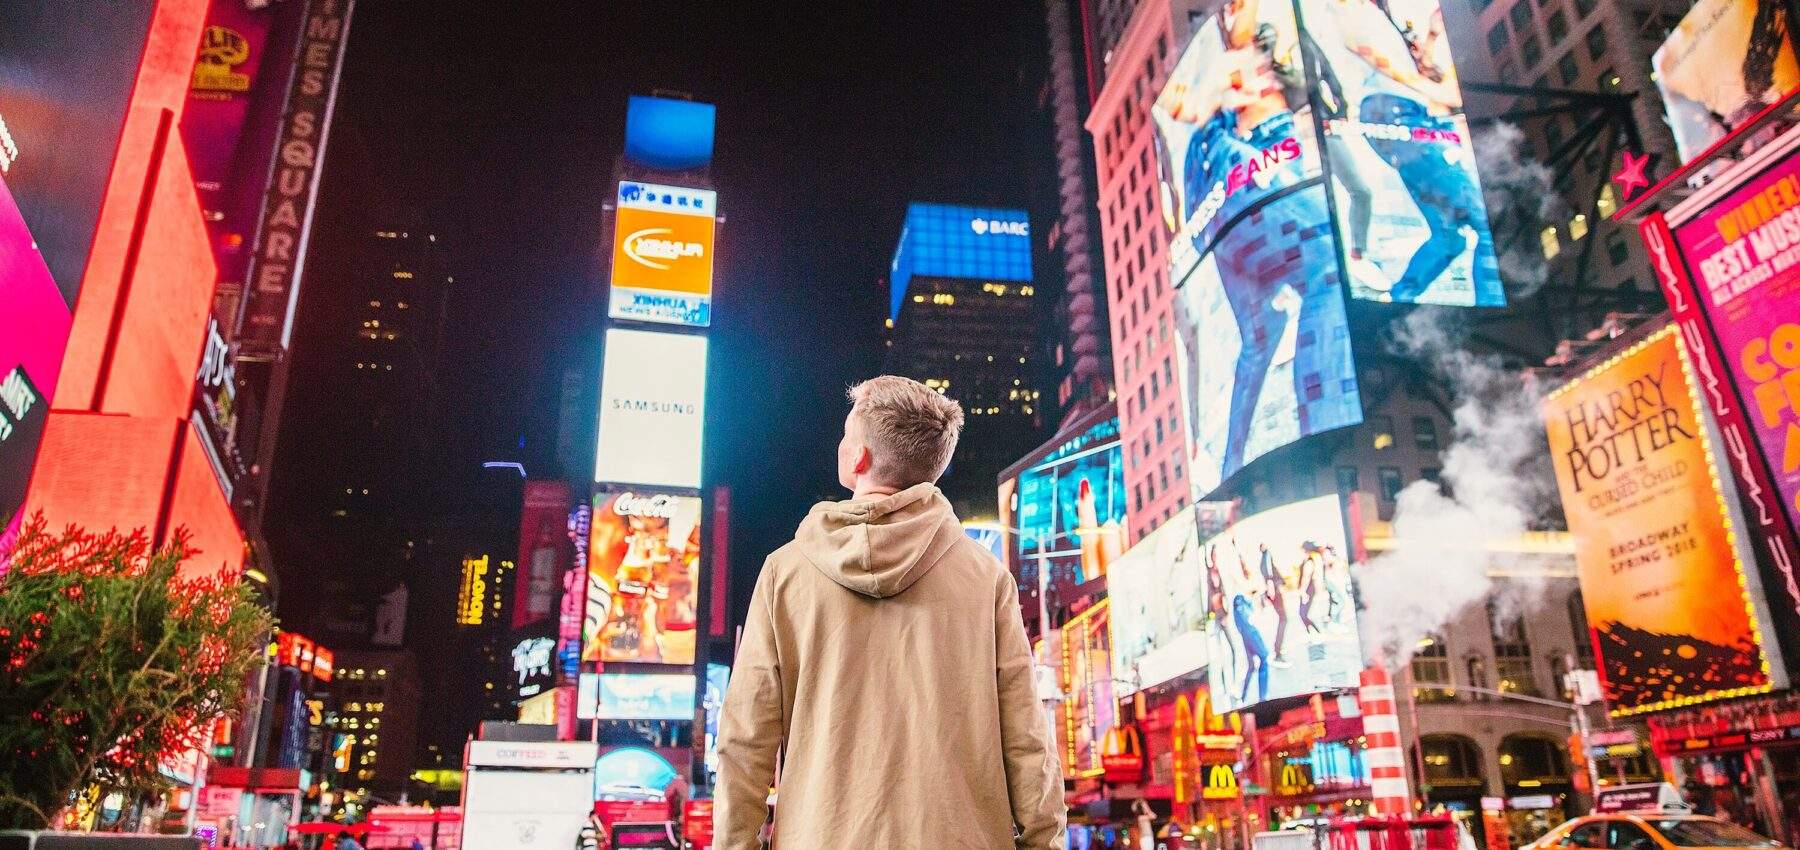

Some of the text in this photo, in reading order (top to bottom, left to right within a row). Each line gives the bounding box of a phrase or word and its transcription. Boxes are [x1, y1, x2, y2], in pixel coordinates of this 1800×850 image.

[1225, 137, 1302, 197] JEANS
[257, 110, 315, 293] SQUARE
[1700, 238, 1751, 291] BEST
[612, 398, 695, 415] SAMSUNG
[1566, 361, 1668, 449] HARRY
[1567, 407, 1695, 493] POTTER
[1641, 459, 1689, 489] CHILD
[1609, 522, 1689, 559] BROADWAY
[1611, 549, 1661, 575] SPRING
[466, 554, 489, 625] NOVOTEL
